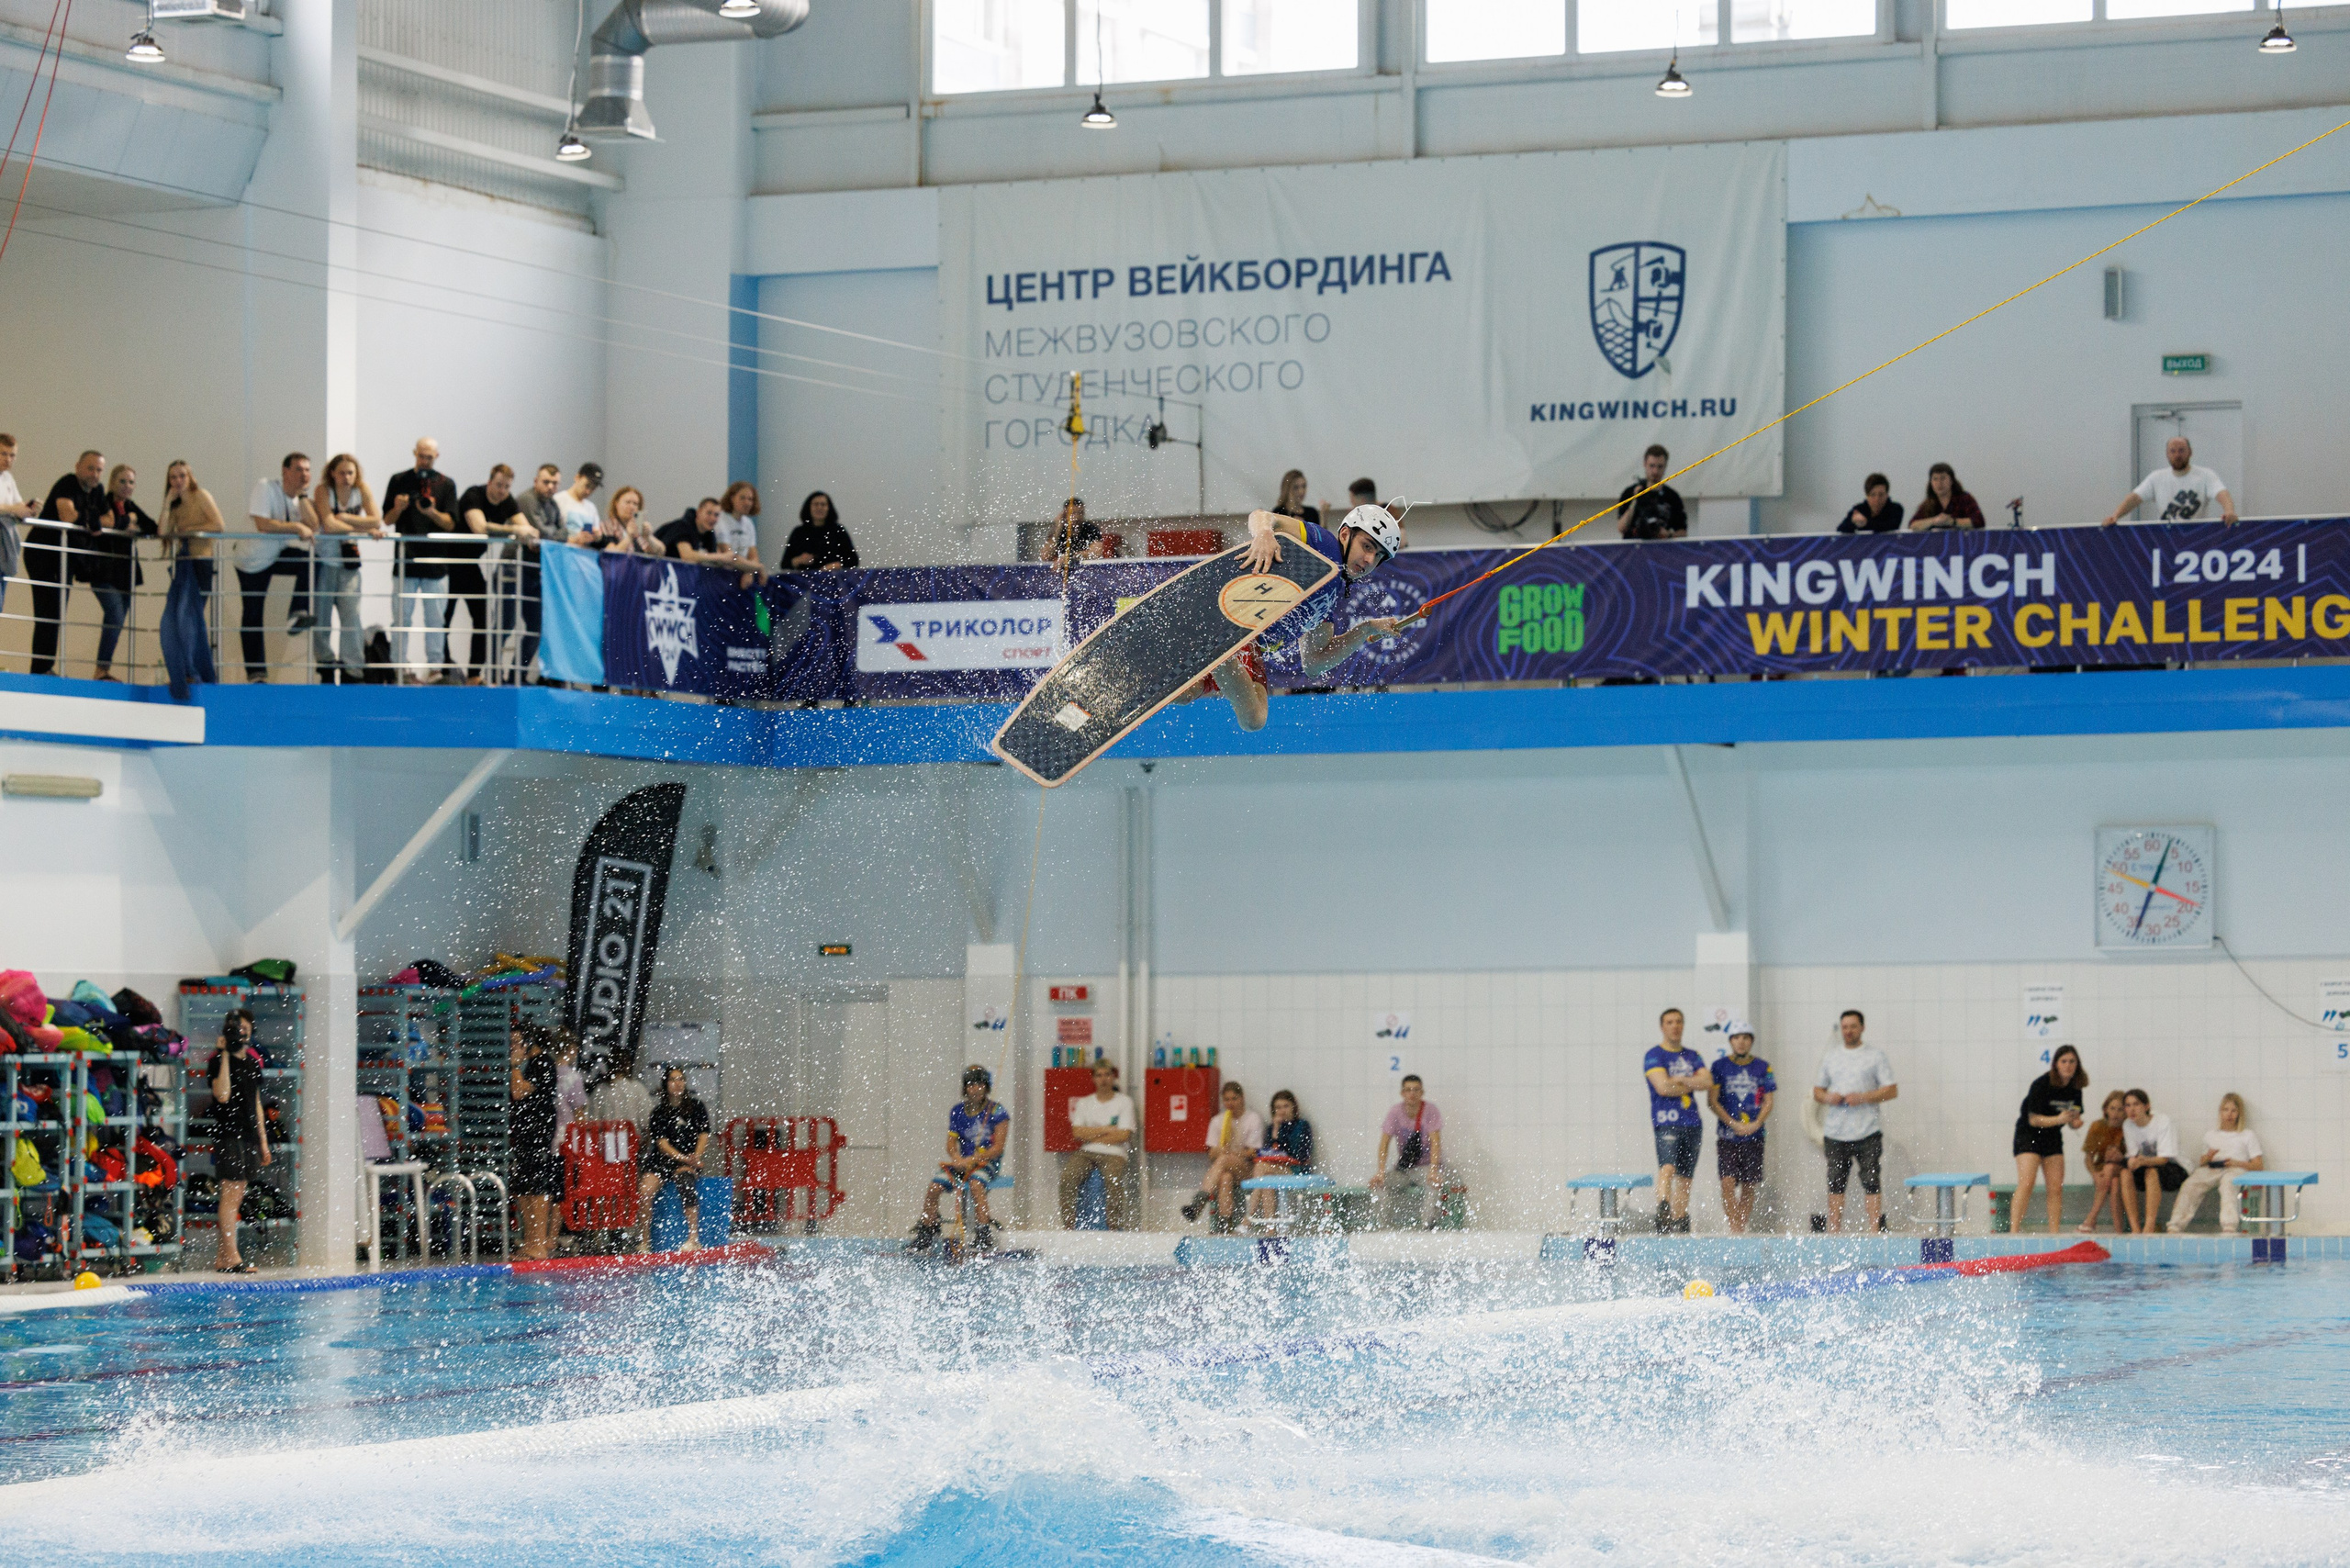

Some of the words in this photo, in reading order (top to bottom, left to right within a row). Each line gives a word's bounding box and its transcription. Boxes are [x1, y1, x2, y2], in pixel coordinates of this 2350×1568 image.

[986, 267, 1115, 311] ЦЕНТР
[1127, 251, 1452, 297] ВЕЙКБОРДИНГА
[984, 312, 1332, 359] МЕЖВУЗОВСКОГО
[984, 360, 1304, 408] СТУДЕНЧЕСКОГО
[1530, 398, 1737, 421] KINGWINCH.RU
[2173, 548, 2284, 583] 2024
[1685, 552, 2056, 609] KINGWINCH
[1498, 582, 1585, 627] GROW
[912, 617, 1053, 638] ТРИКОЛОР
[1498, 608, 1585, 655] FOOD
[1746, 605, 1993, 655] WINTER
[2013, 593, 2350, 648] CHALLENG
[2178, 860, 2193, 873] 10
[2186, 880, 2200, 893] 15
[603, 879, 636, 922] 21
[2113, 902, 2129, 914] 40
[2165, 915, 2180, 928] 25
[2040, 1049, 2051, 1063] 4
[2337, 1043, 2349, 1058] 5
[1390, 1056, 1401, 1071] 2
[1656, 1109, 1679, 1123] 50
